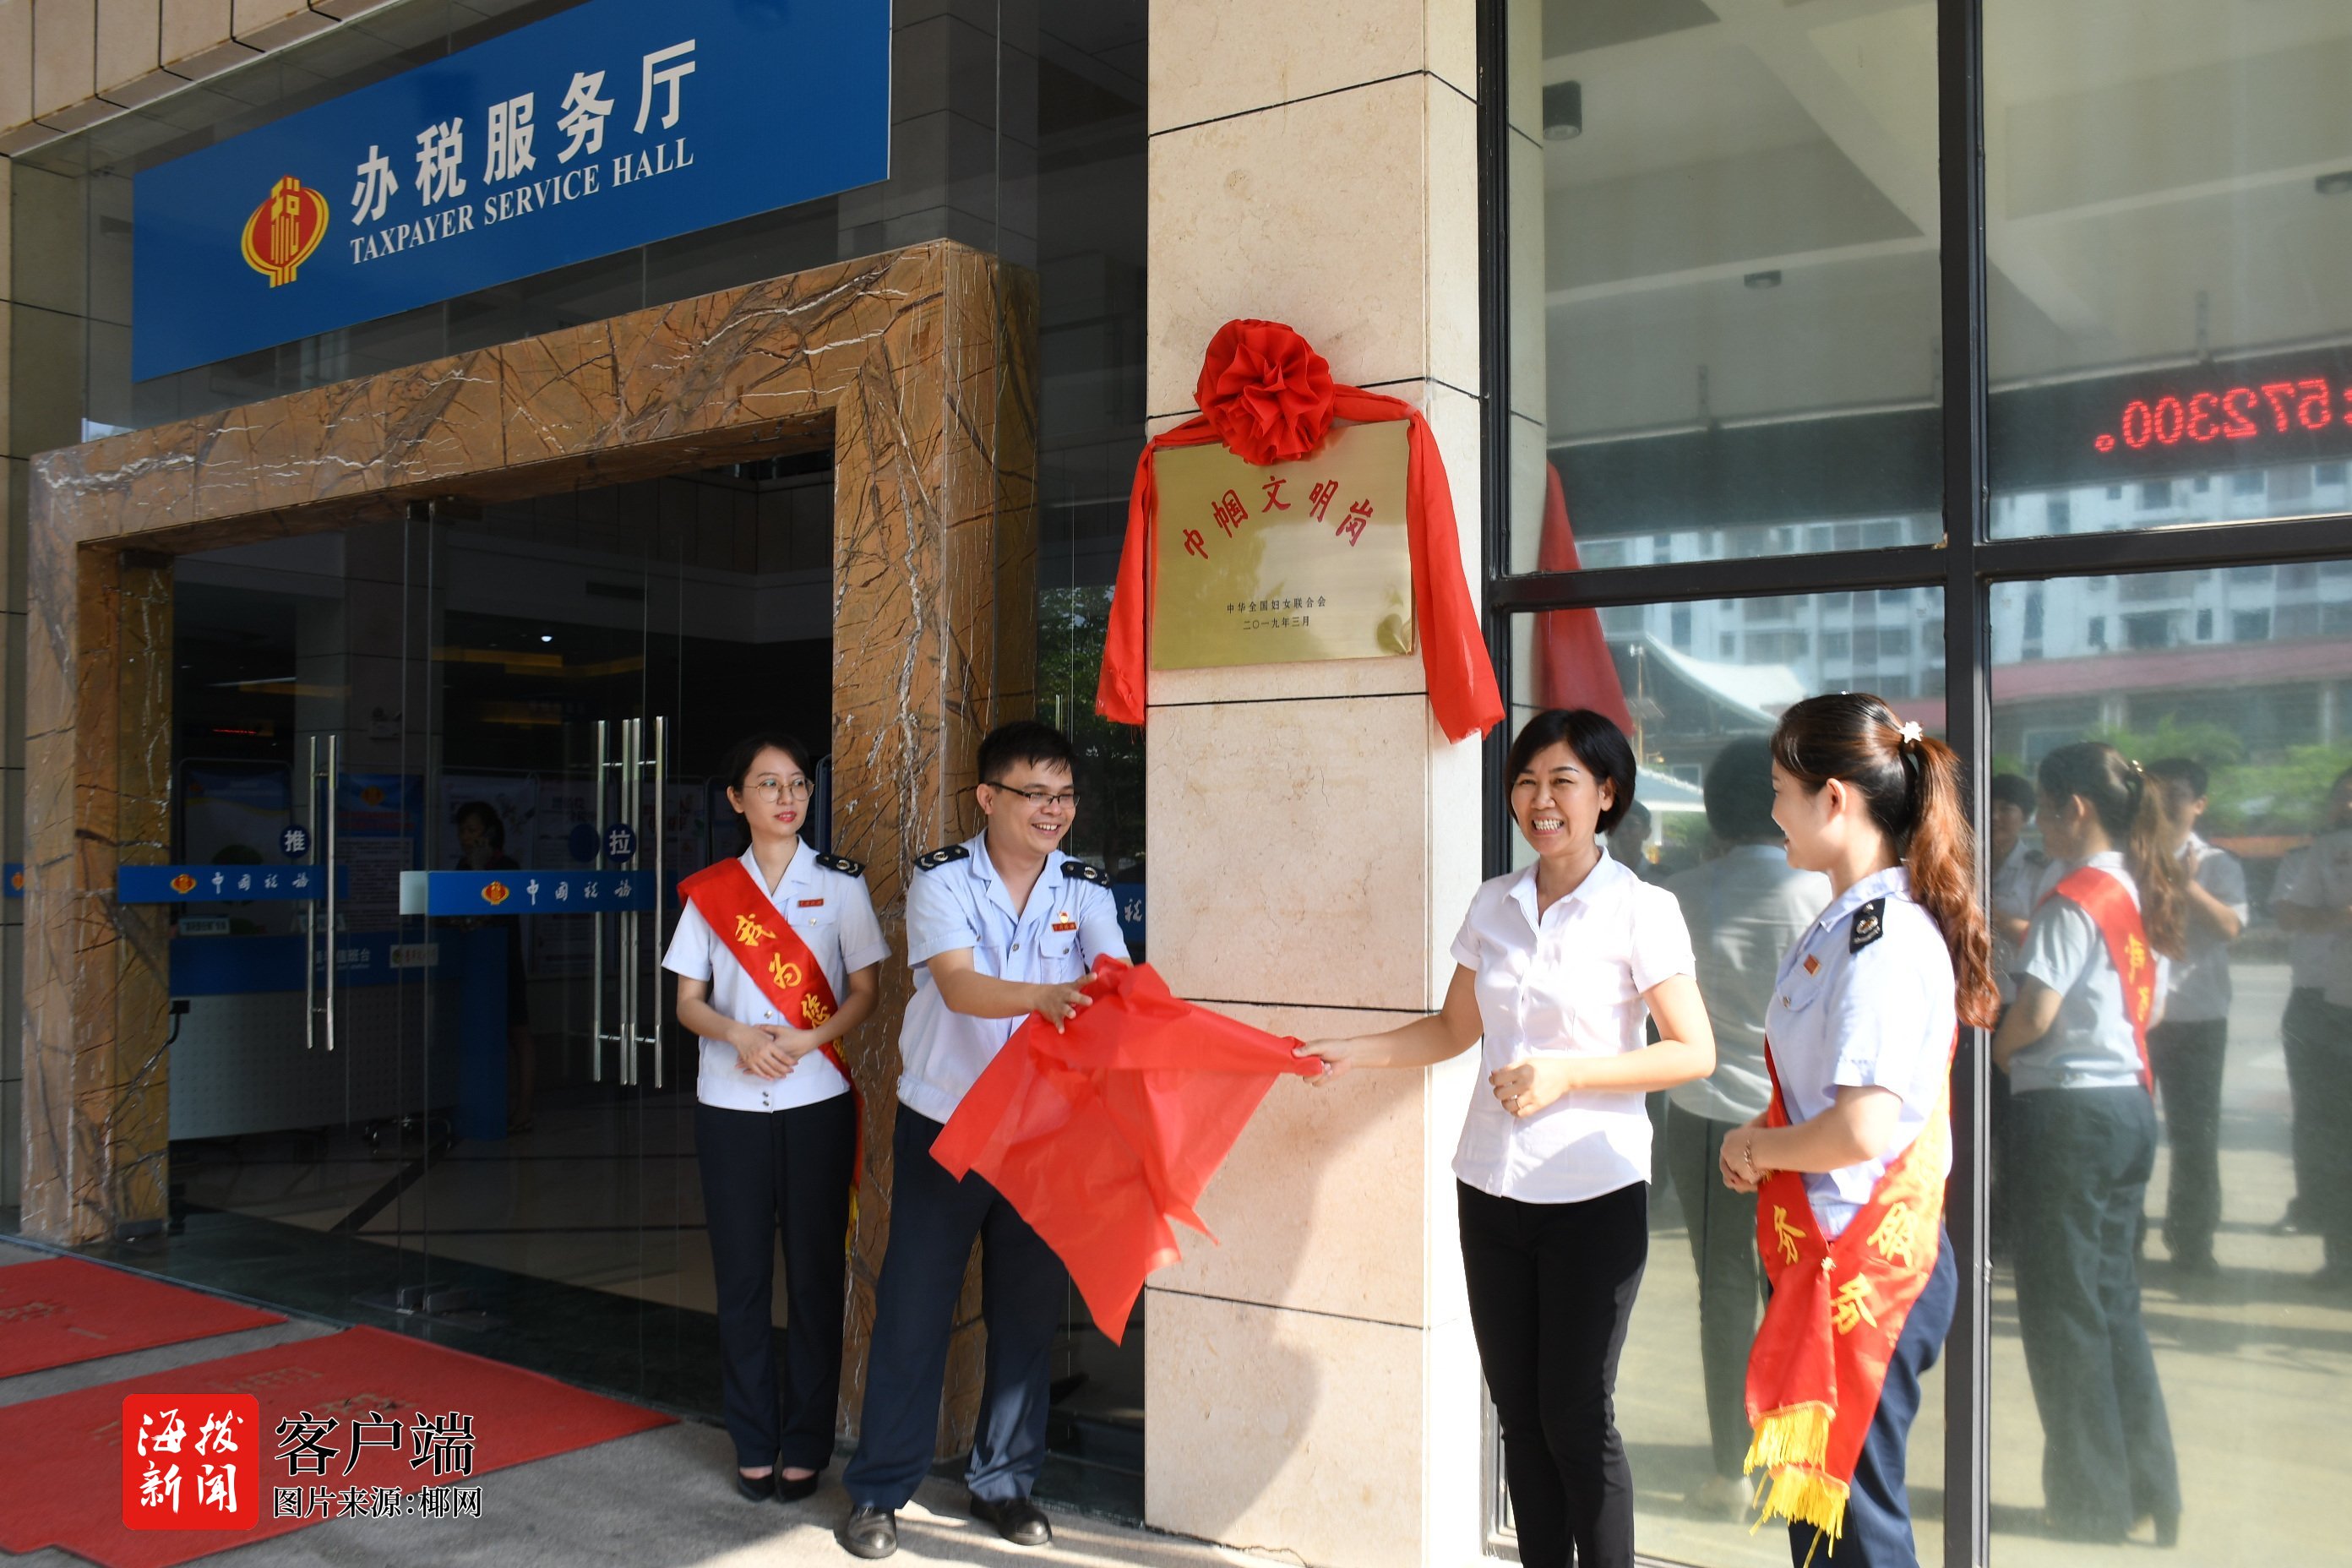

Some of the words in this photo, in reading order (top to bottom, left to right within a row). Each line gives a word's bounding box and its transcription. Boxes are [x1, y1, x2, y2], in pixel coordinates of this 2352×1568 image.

[351, 39, 695, 226] 办税服务厅
[350, 204, 474, 264] TAXPAYER
[484, 165, 600, 226] SERVICE
[612, 138, 694, 188] HALL
[1183, 476, 1374, 559] 巾帼文明岗
[1227, 595, 1326, 614] 中华全国妇女联合会
[284, 830, 306, 852] 推
[609, 830, 631, 856] 拉
[211, 871, 310, 894] 中国税务
[526, 879, 633, 906] 中国税务
